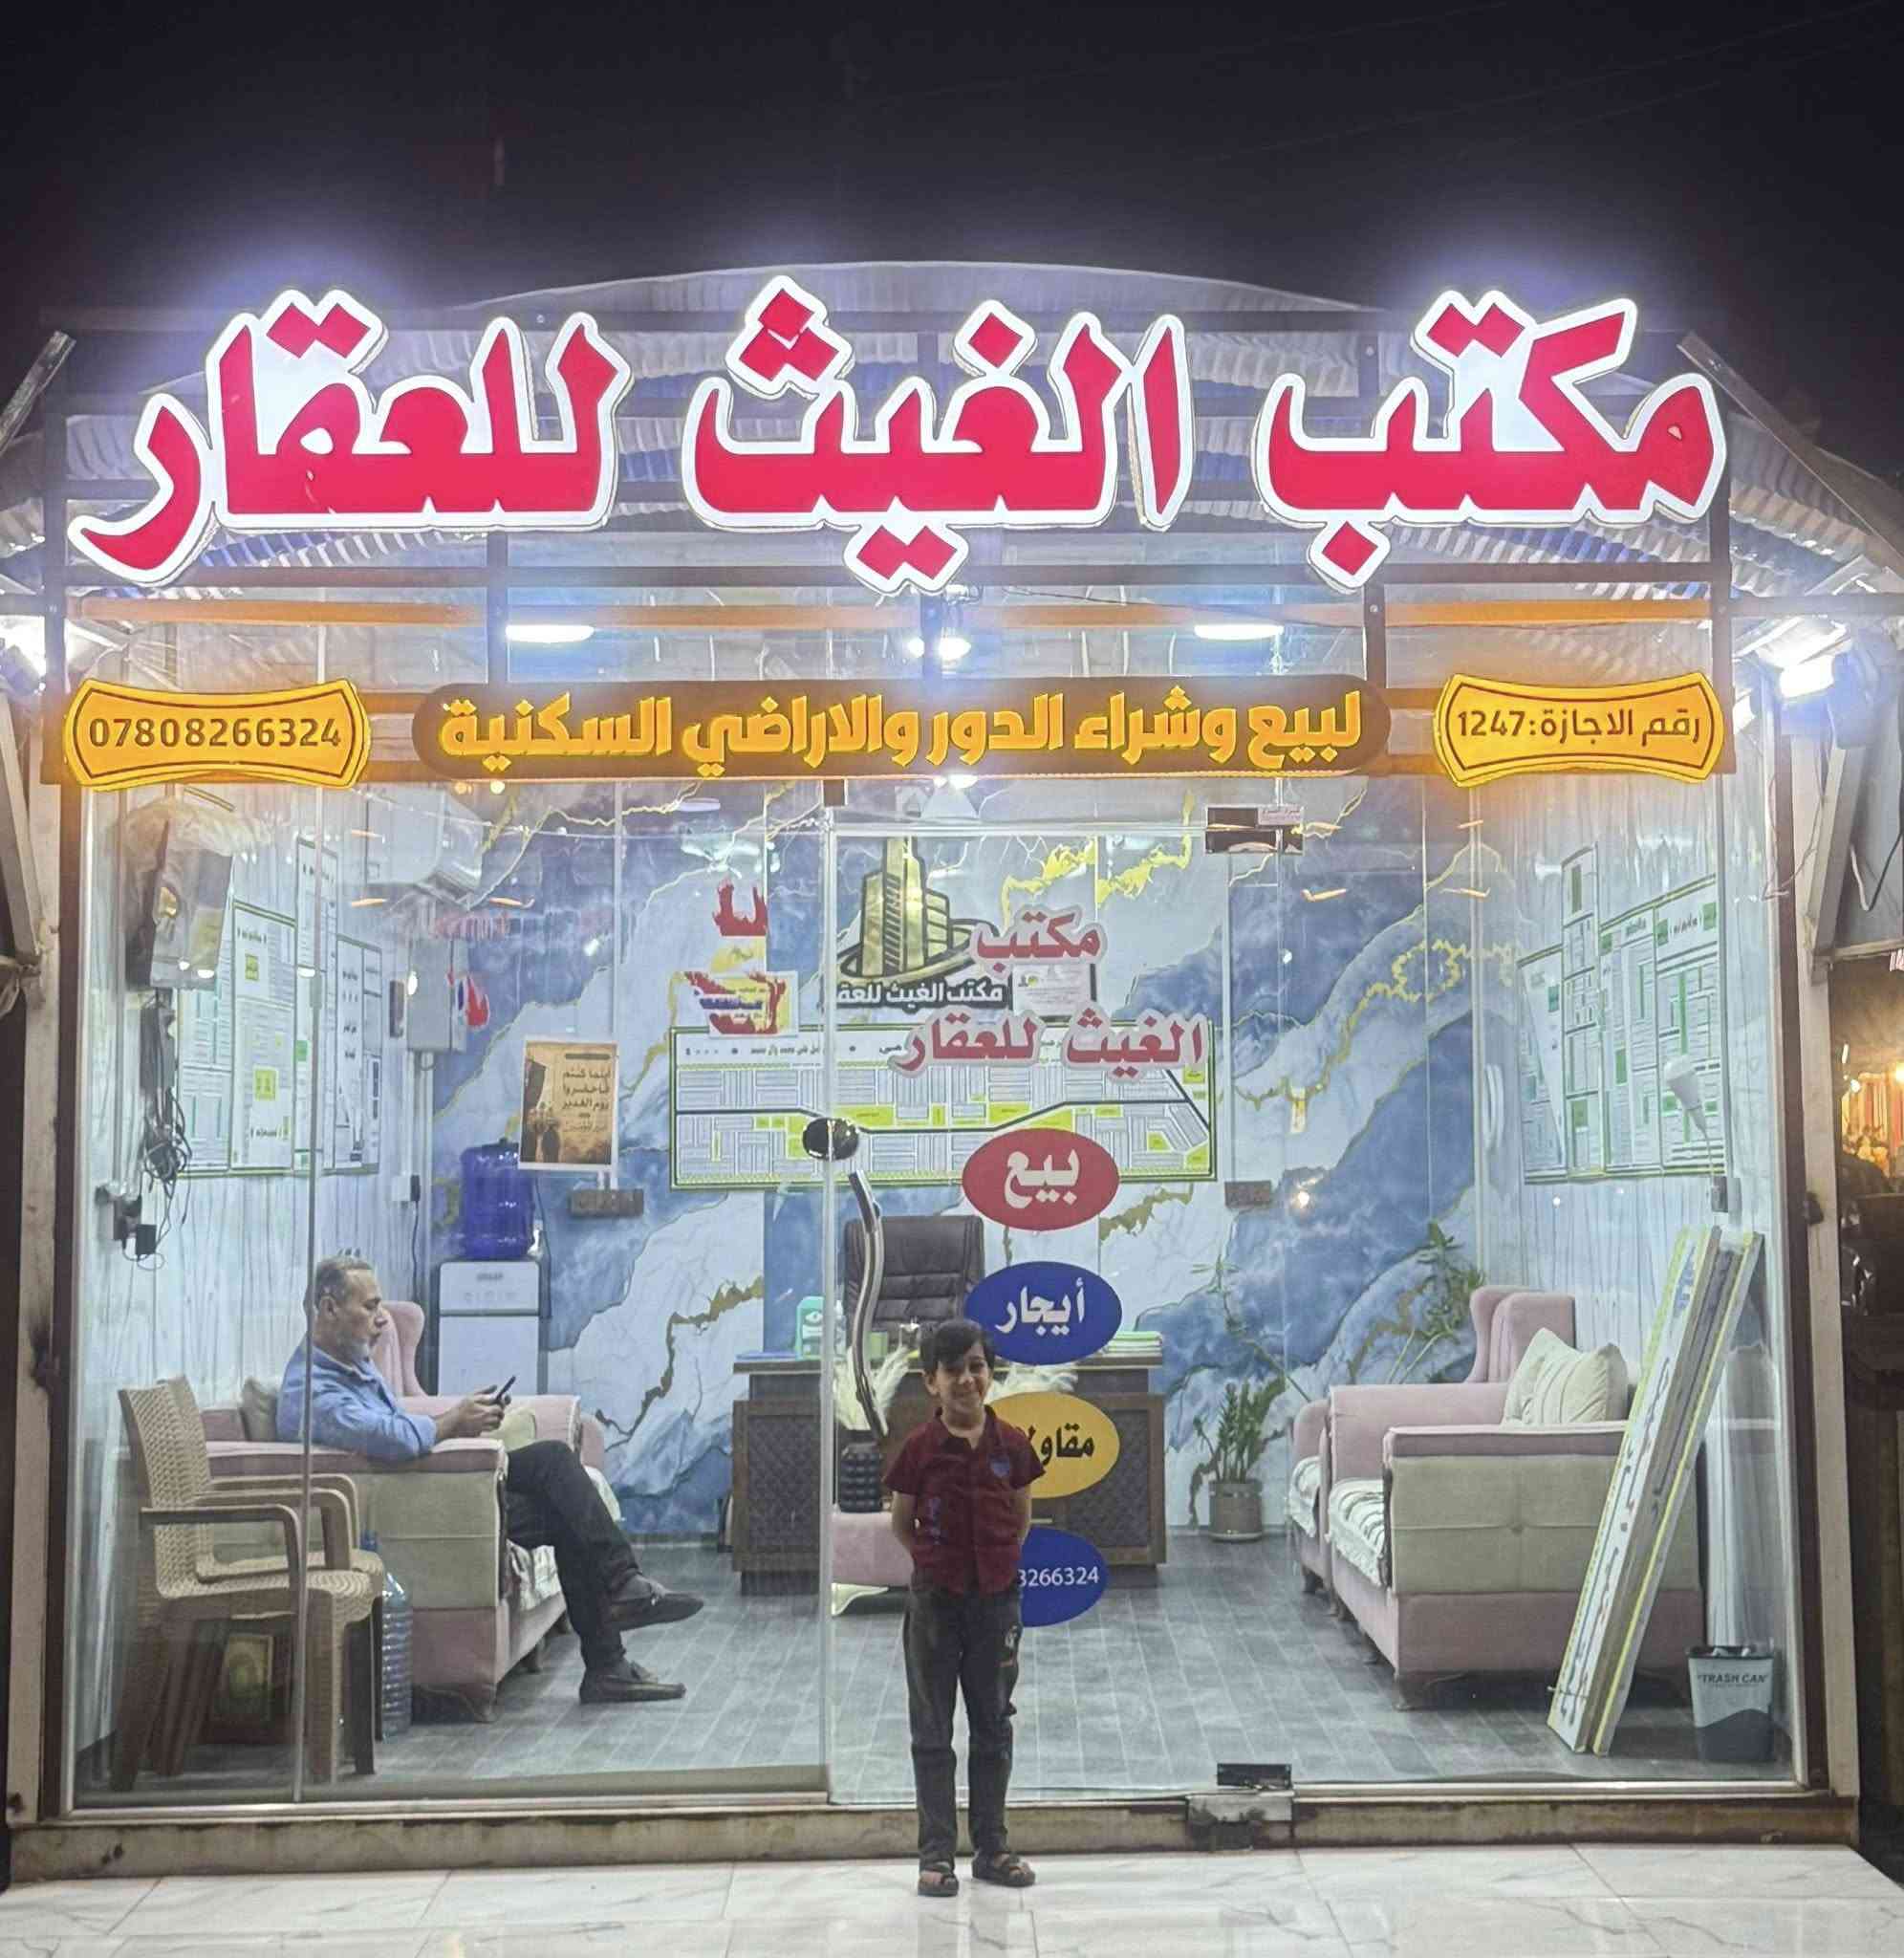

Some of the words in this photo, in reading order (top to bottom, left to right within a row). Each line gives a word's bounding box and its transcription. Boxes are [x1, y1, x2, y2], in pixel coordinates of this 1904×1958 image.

[67, 289, 631, 584] للعقار
[684, 275, 1193, 595] الغيث
[1253, 290, 1726, 589] مكتب
[89, 718, 341, 747] 07808266324
[441, 691, 672, 772] السكنية
[681, 694, 920, 777] والاراضي
[925, 692, 1064, 765] الدور
[1073, 685, 1237, 765] وشراء
[1247, 689, 1361, 769] لبيع
[1641, 708, 1700, 747] رقم
[974, 908, 1103, 974] مكتب
[886, 980, 945, 1009] الغيث
[946, 976, 1004, 1004] مكتب
[892, 1010, 1040, 1074] للعقار
[1064, 1006, 1204, 1079] الغيث
[1004, 1148, 1081, 1209] بيع
[994, 1276, 1086, 1337] أيجار
